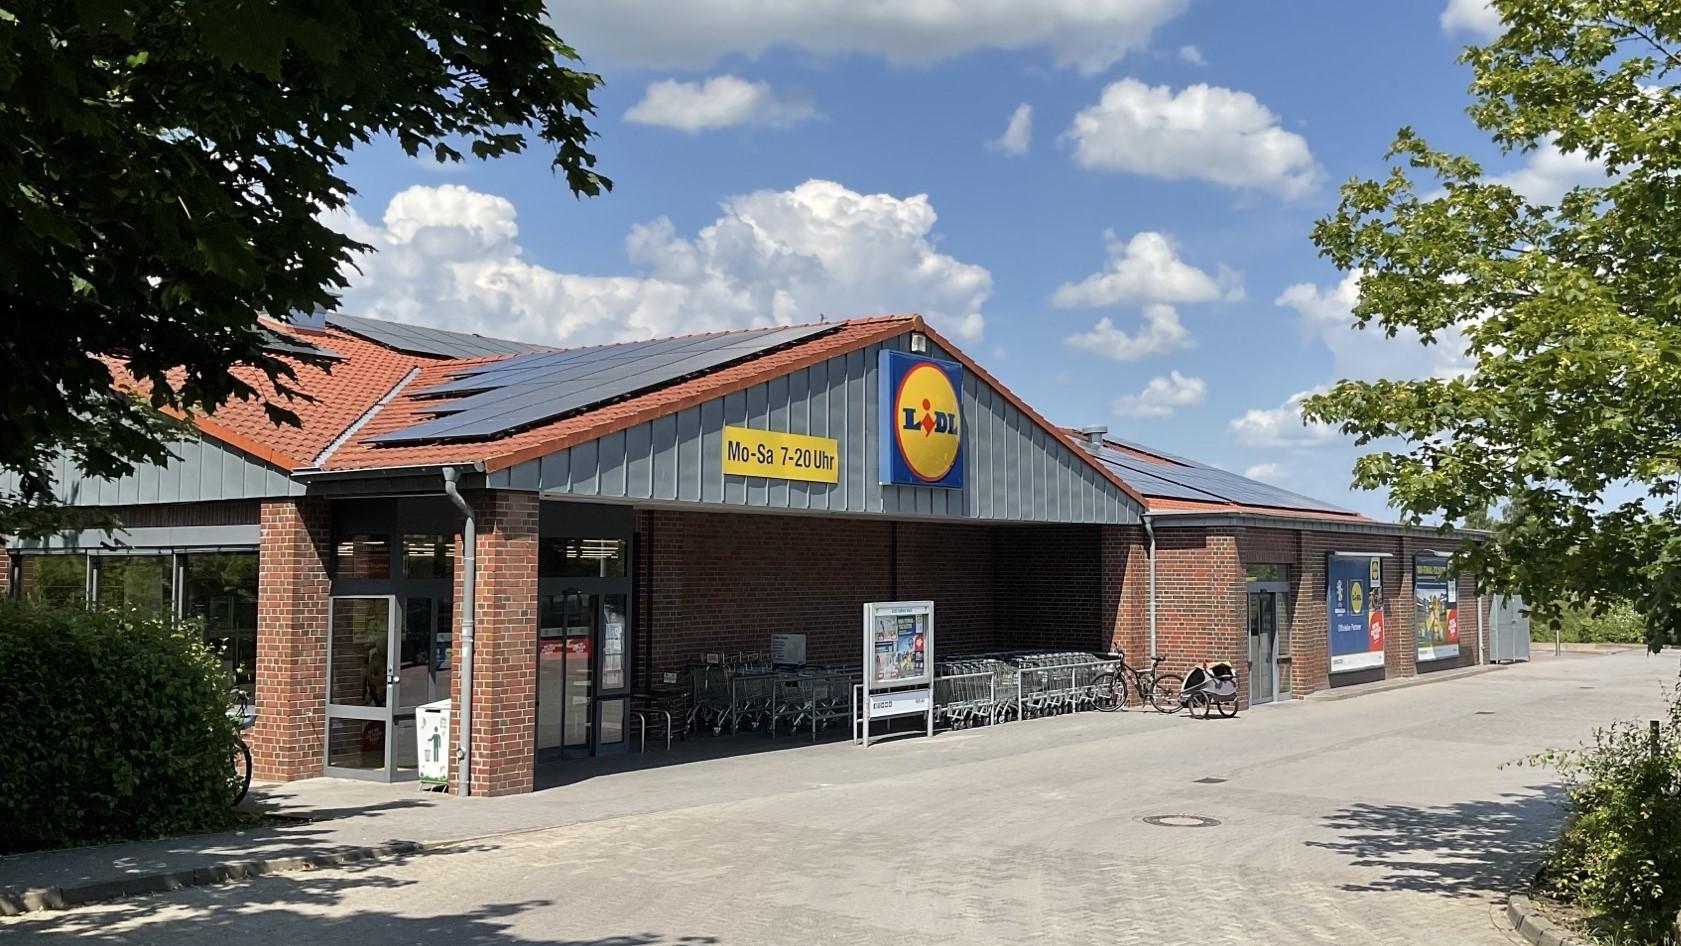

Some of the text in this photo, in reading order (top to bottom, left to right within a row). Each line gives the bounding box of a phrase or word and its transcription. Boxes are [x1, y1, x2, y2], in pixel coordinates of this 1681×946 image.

[728, 440, 834, 470] Mo-Sa 7-20 Uhr
